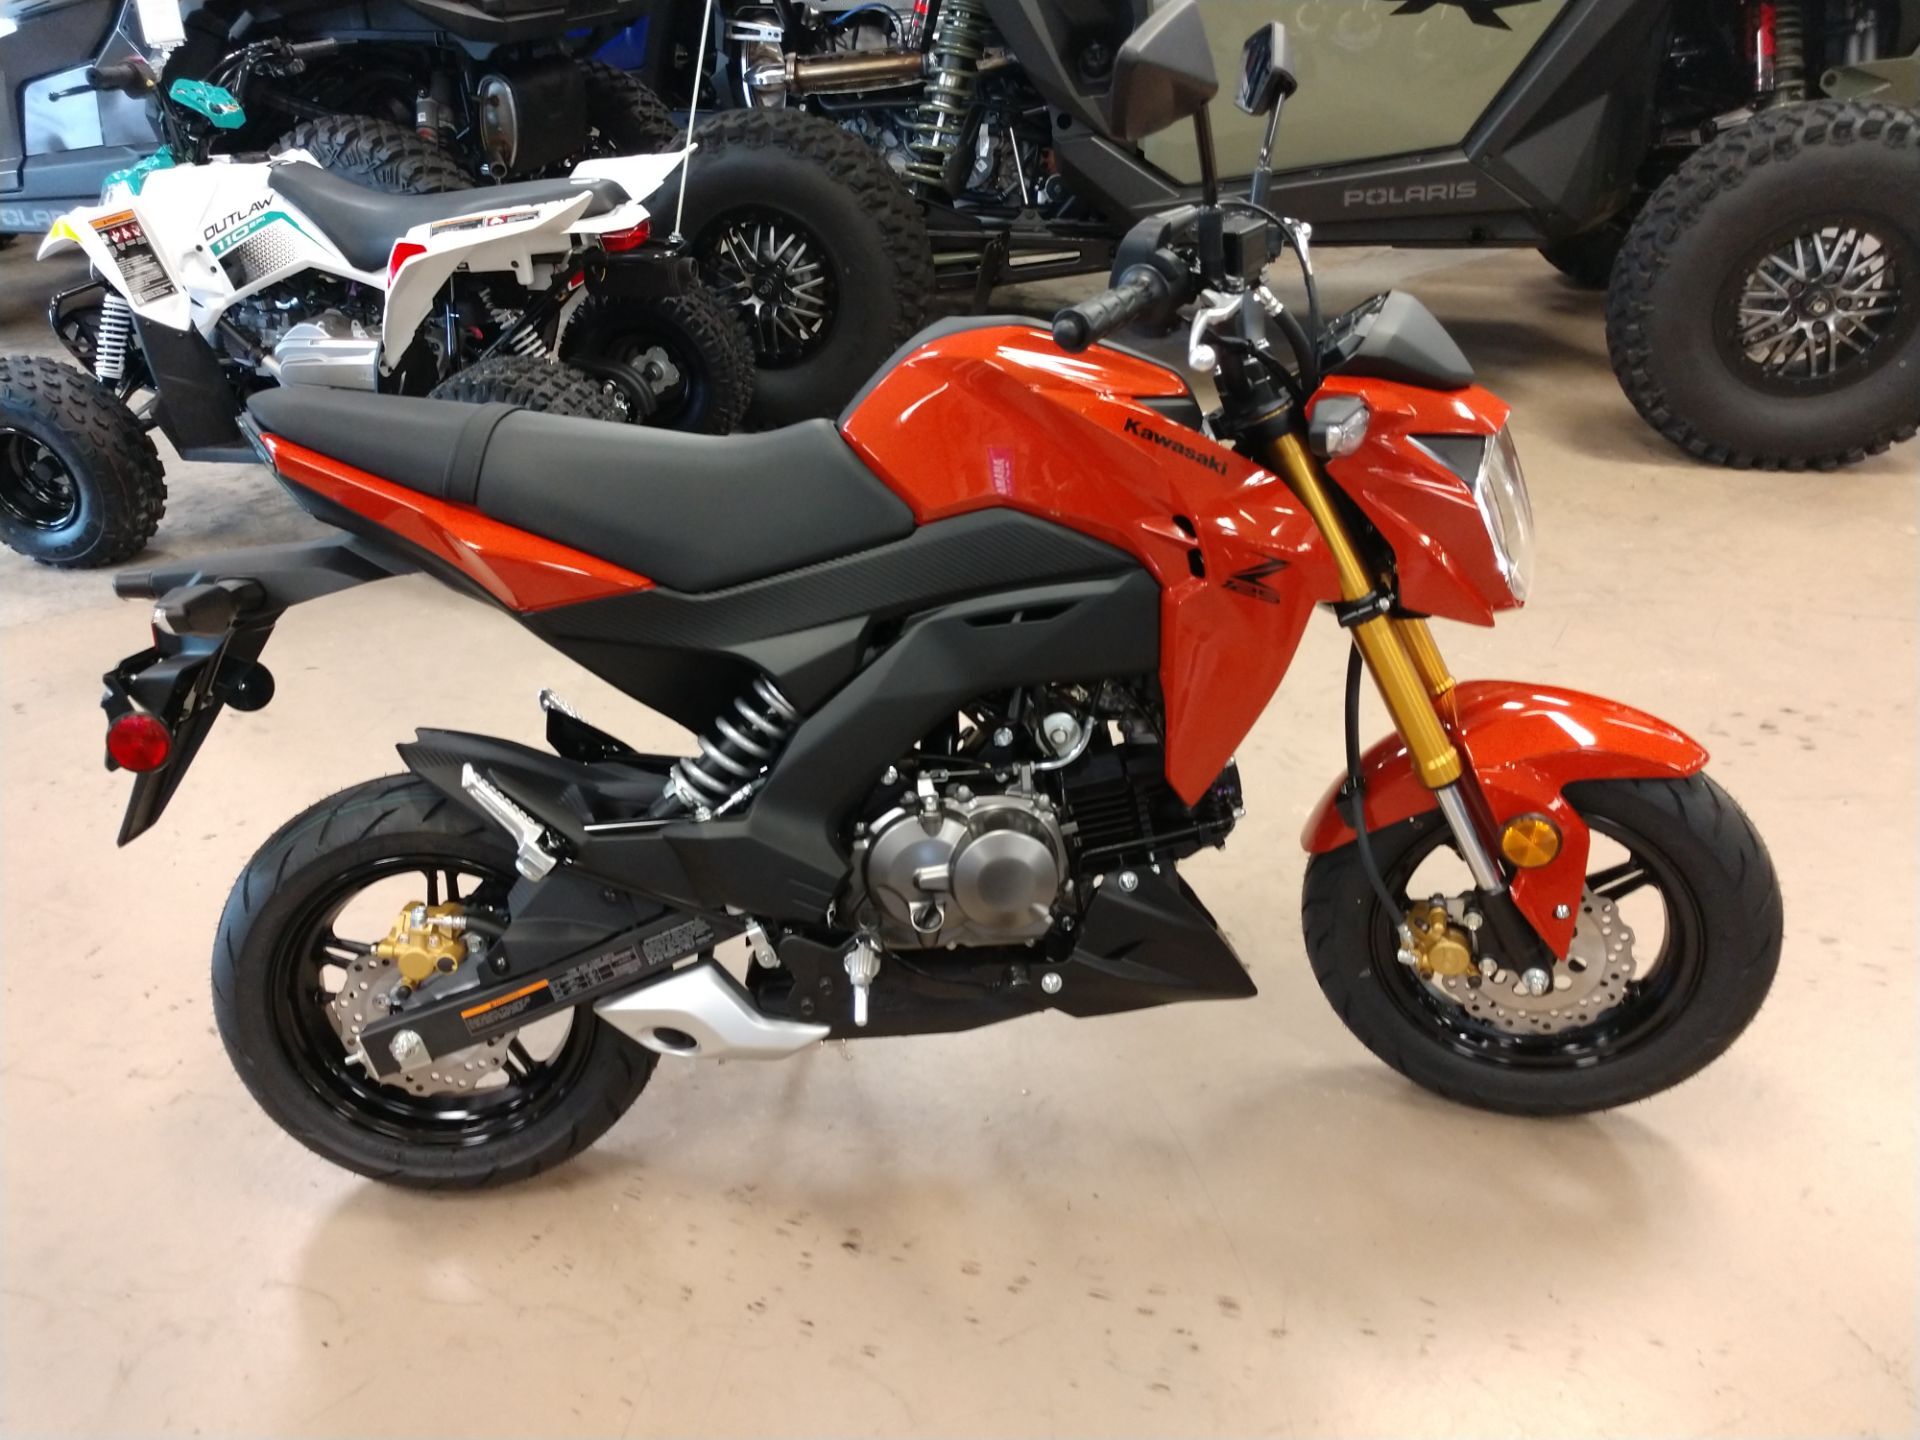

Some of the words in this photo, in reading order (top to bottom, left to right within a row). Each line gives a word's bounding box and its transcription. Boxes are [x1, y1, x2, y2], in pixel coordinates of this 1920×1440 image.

[1343, 181, 1478, 208] POLARIS
[203, 194, 274, 242] OUTLAW
[217, 224, 250, 251] 110
[1123, 416, 1227, 476] Kawasaki
